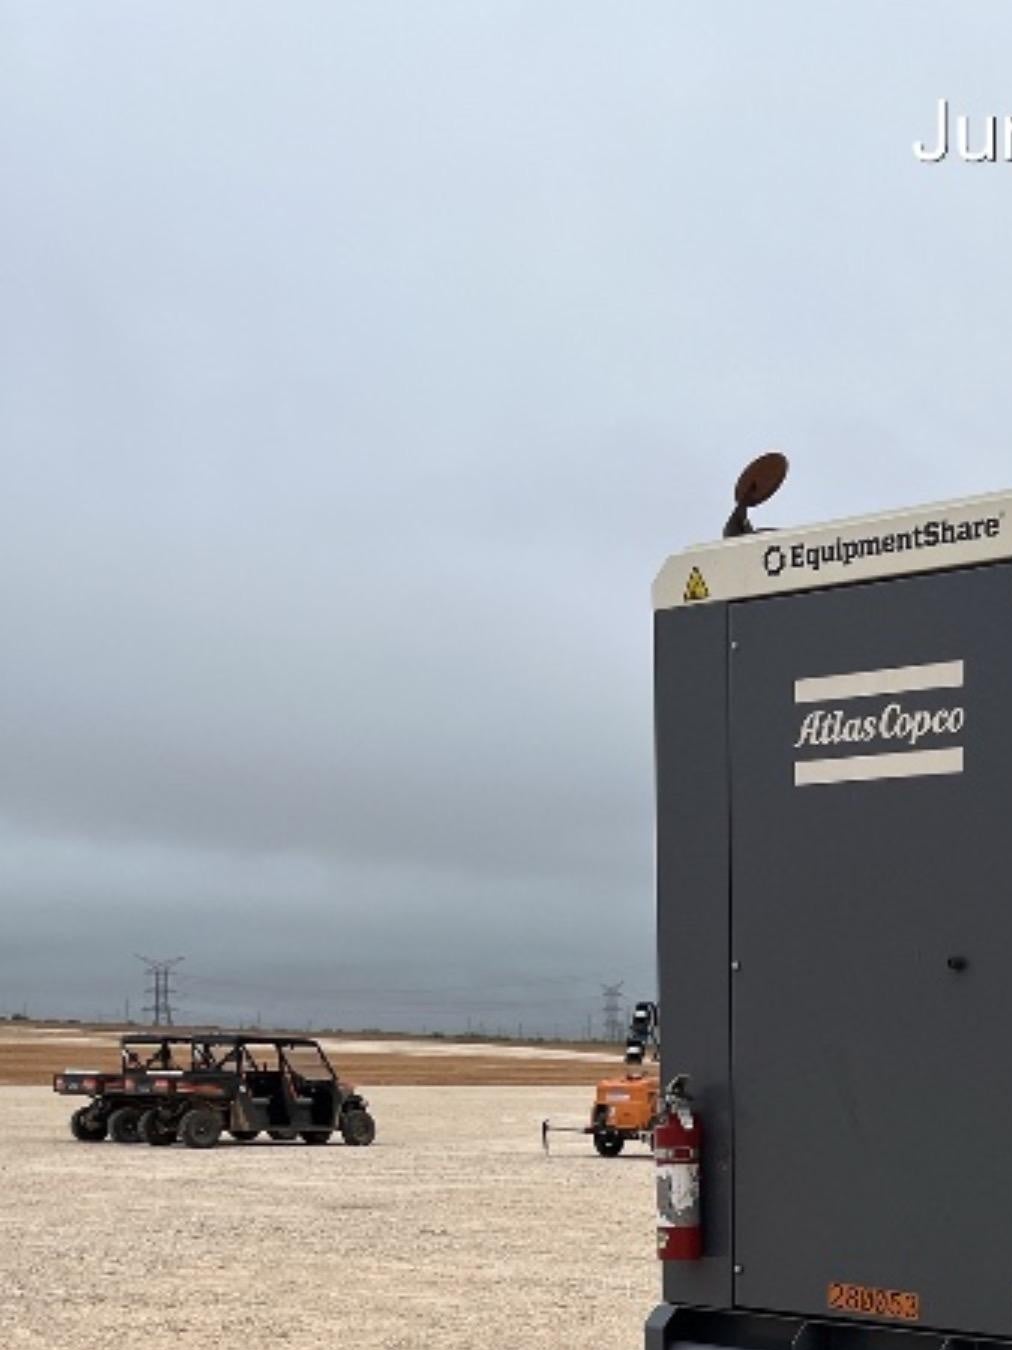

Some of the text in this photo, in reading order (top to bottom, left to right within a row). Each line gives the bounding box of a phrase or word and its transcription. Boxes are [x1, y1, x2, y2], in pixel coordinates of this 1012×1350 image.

[790, 518, 1000, 571] EquipmentShare
[793, 703, 965, 748] Atlas Copco
